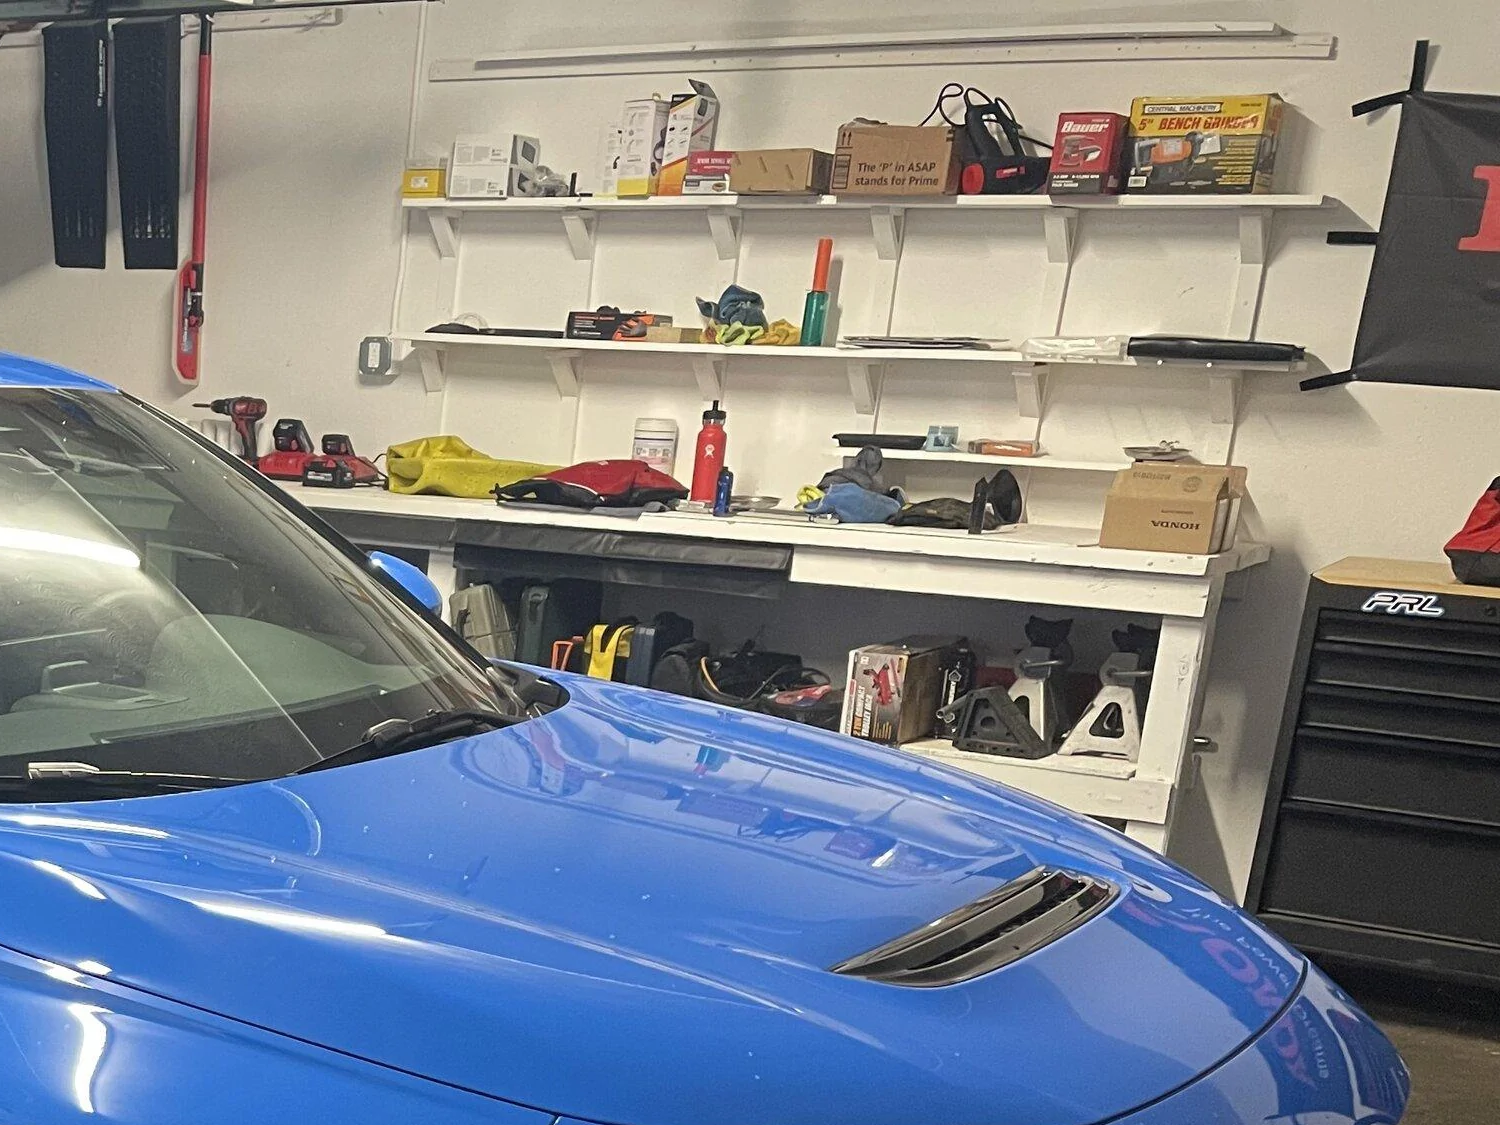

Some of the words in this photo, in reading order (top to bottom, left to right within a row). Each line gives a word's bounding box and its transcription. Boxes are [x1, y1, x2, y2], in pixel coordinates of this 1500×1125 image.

[1147, 105, 1178, 113] CENTRAL
[1179, 104, 1218, 112] MACHINERY
[1060, 121, 1110, 133] Bauer
[1158, 117, 1202, 131] BENCH
[858, 162, 876, 173] The
[895, 162, 905, 172] in
[907, 162, 936, 172] ASAP
[855, 175, 889, 186] stands
[890, 175, 906, 186] for
[908, 176, 939, 186] Prime
[1150, 519, 1202, 531] HONDA
[1360, 592, 1446, 618] PRL
